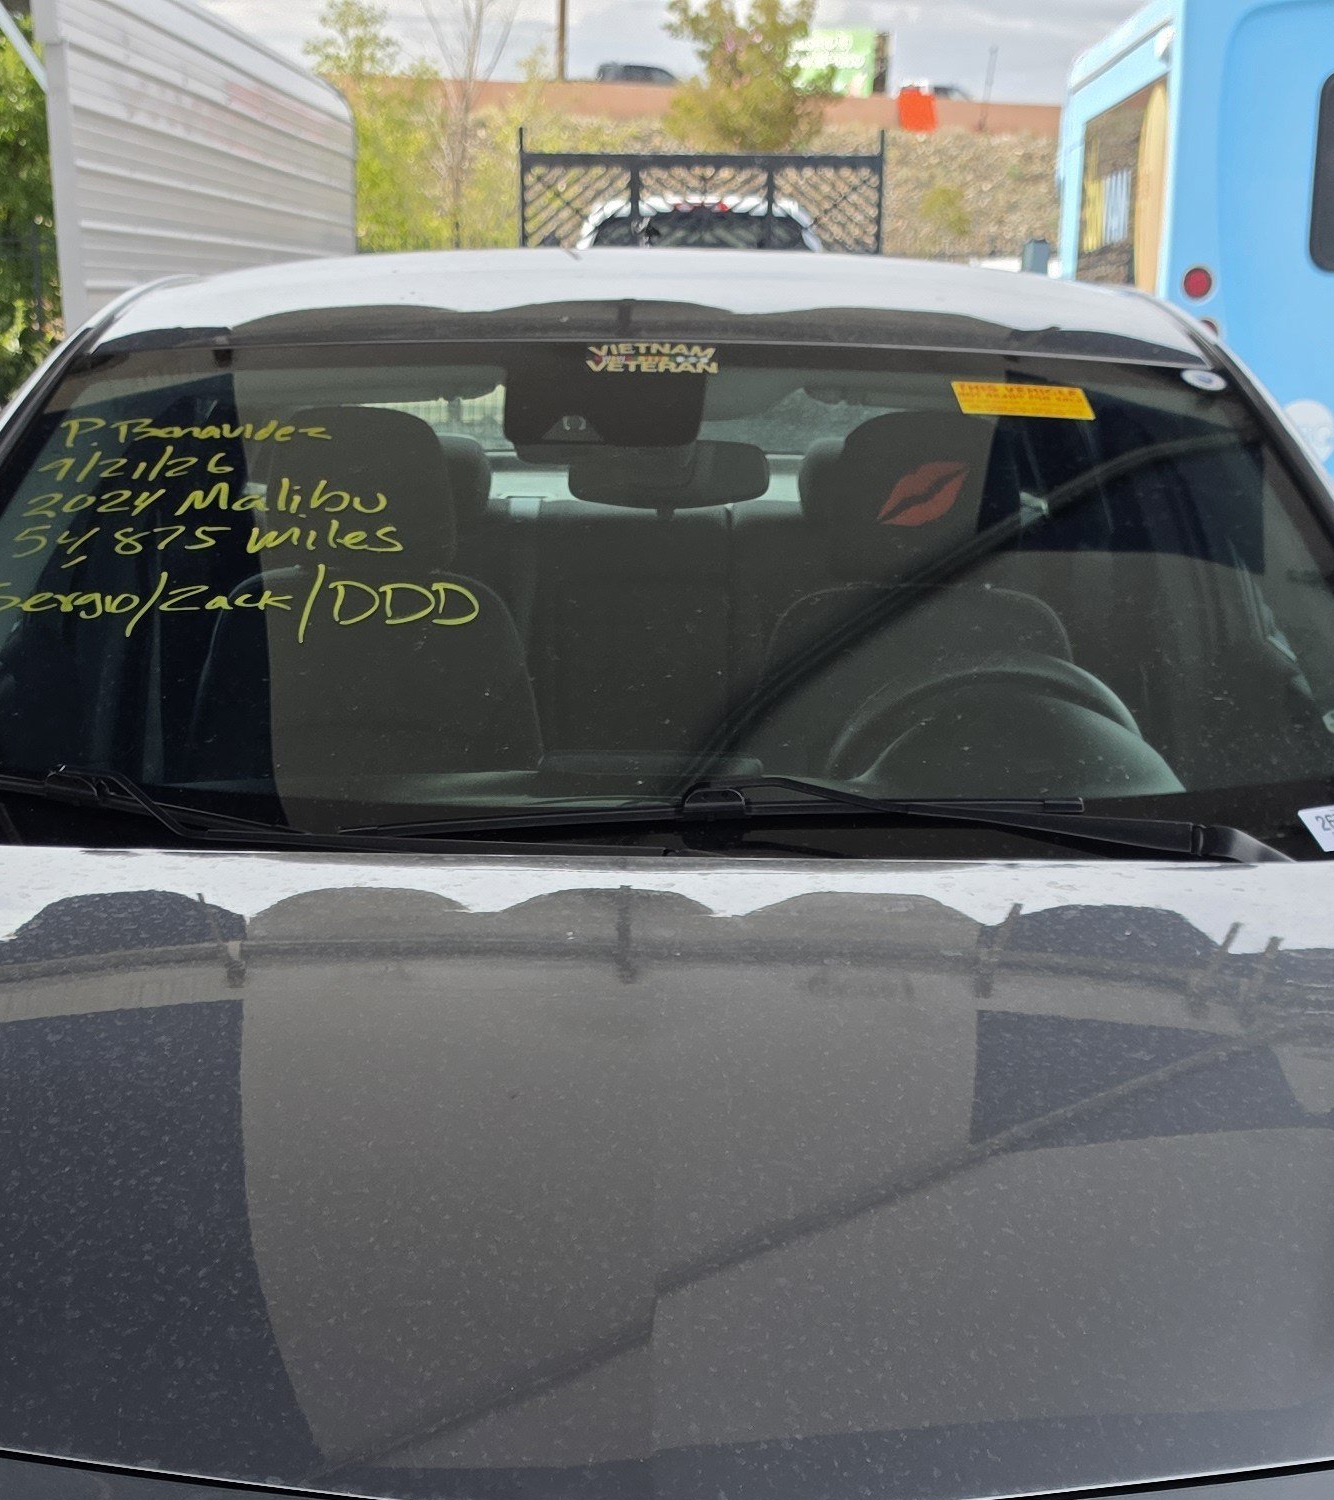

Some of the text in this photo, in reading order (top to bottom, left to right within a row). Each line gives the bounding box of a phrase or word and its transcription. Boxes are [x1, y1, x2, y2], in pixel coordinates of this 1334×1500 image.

[588, 343, 716, 359] VIETNAM
[586, 360, 719, 373] VETERAN
[60, 417, 107, 447] P.
[22, 477, 387, 518] 2024 Malibu
